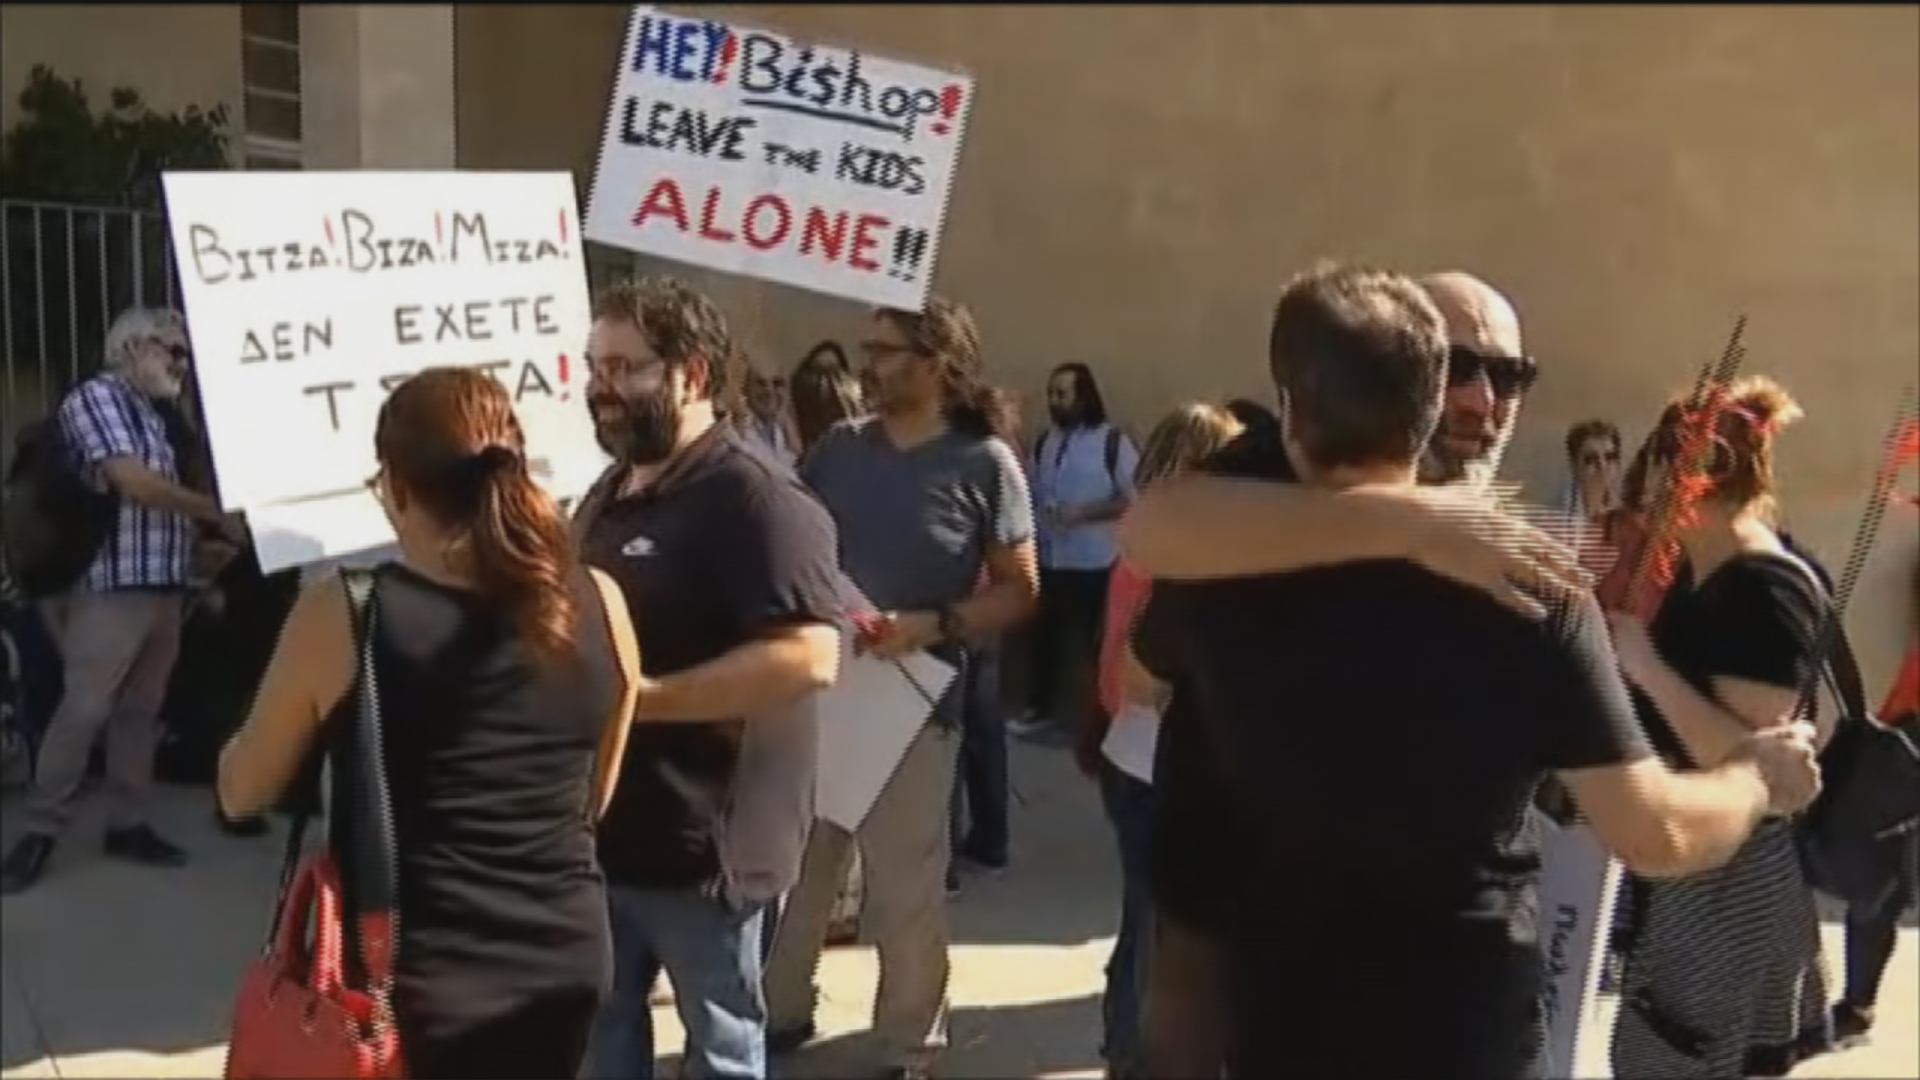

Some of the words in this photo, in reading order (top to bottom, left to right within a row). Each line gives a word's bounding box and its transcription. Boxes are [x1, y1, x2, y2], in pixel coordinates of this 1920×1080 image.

[631, 15, 737, 86] HEY!
[738, 34, 962, 142] Bishop!
[620, 95, 757, 160] LEAVE
[763, 141, 821, 174] THE
[836, 140, 926, 195] KIDS
[239, 317, 334, 364] ΔΕΝ
[394, 294, 560, 345] ΕΧΕΤΕ
